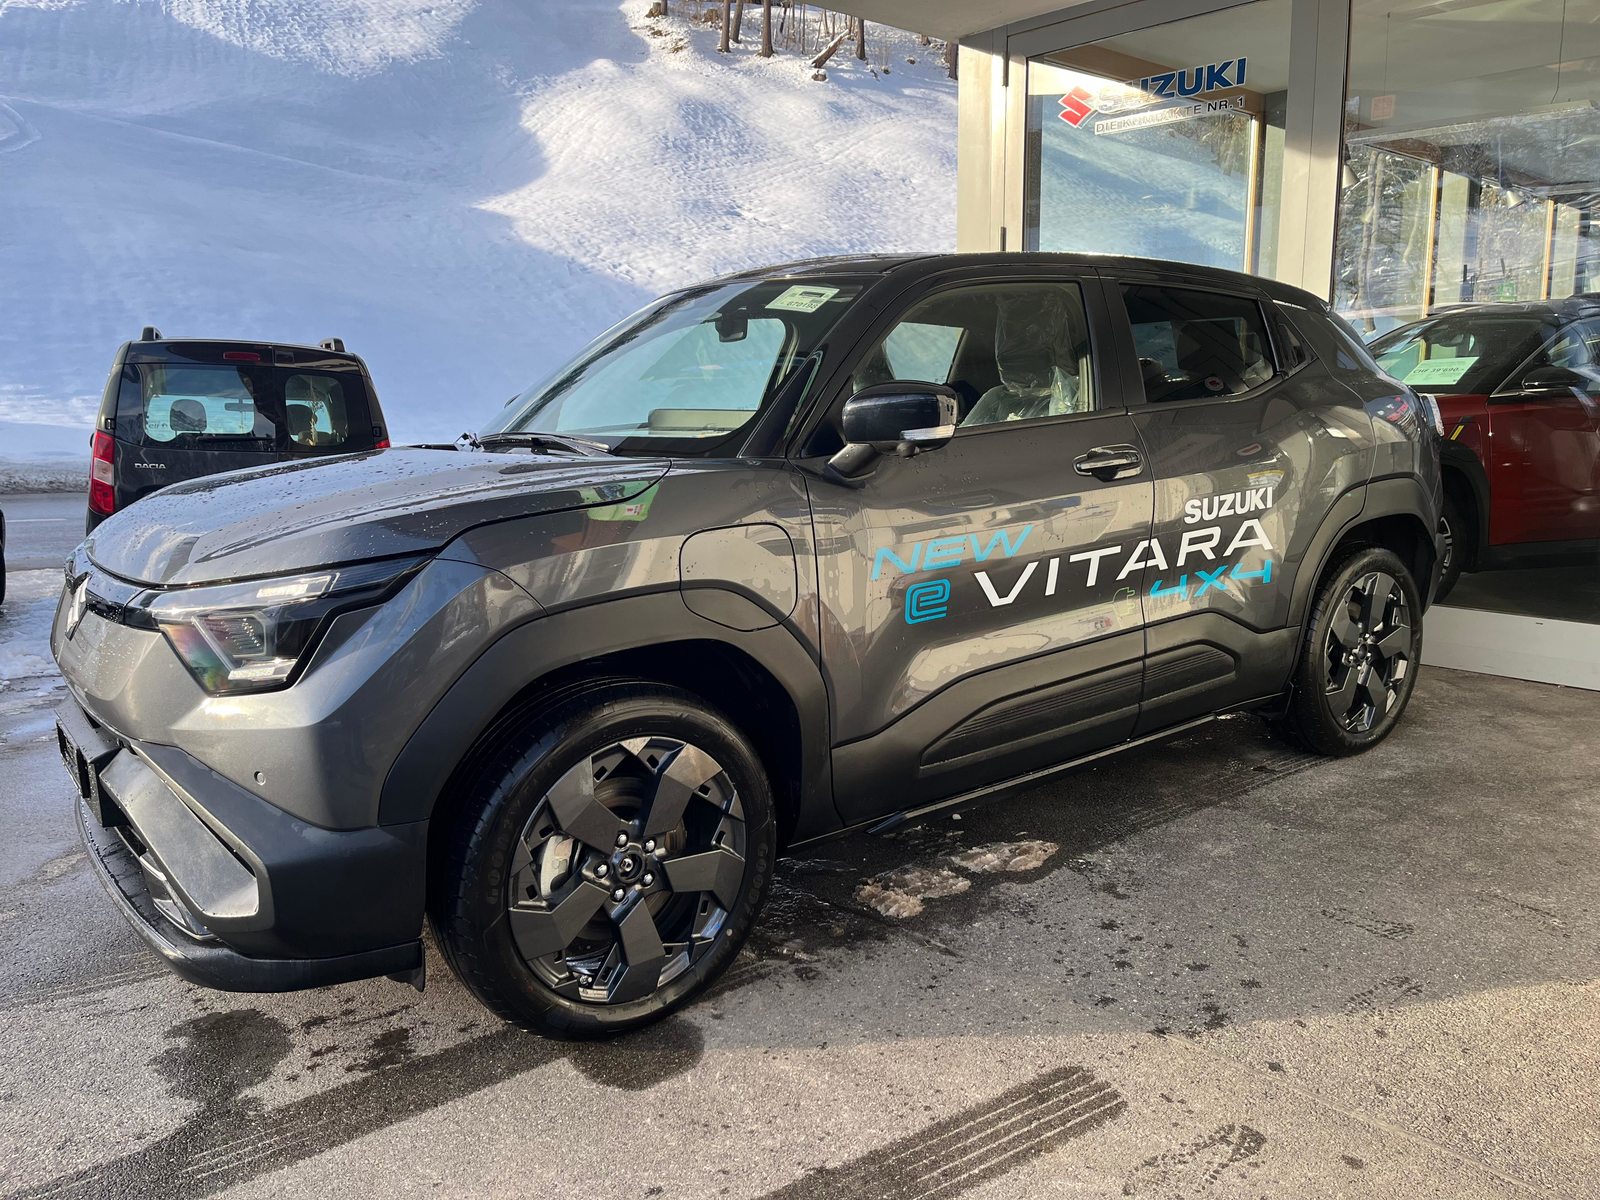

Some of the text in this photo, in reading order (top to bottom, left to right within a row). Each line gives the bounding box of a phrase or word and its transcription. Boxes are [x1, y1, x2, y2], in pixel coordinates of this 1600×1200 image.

[1096, 121, 1118, 133] DIE
[1207, 99, 1233, 112] NR.
[1237, 97, 1244, 107] 1
[1183, 487, 1273, 525] SUZUKI
[870, 523, 1036, 581] NEW
[974, 518, 1273, 608] VITARA
